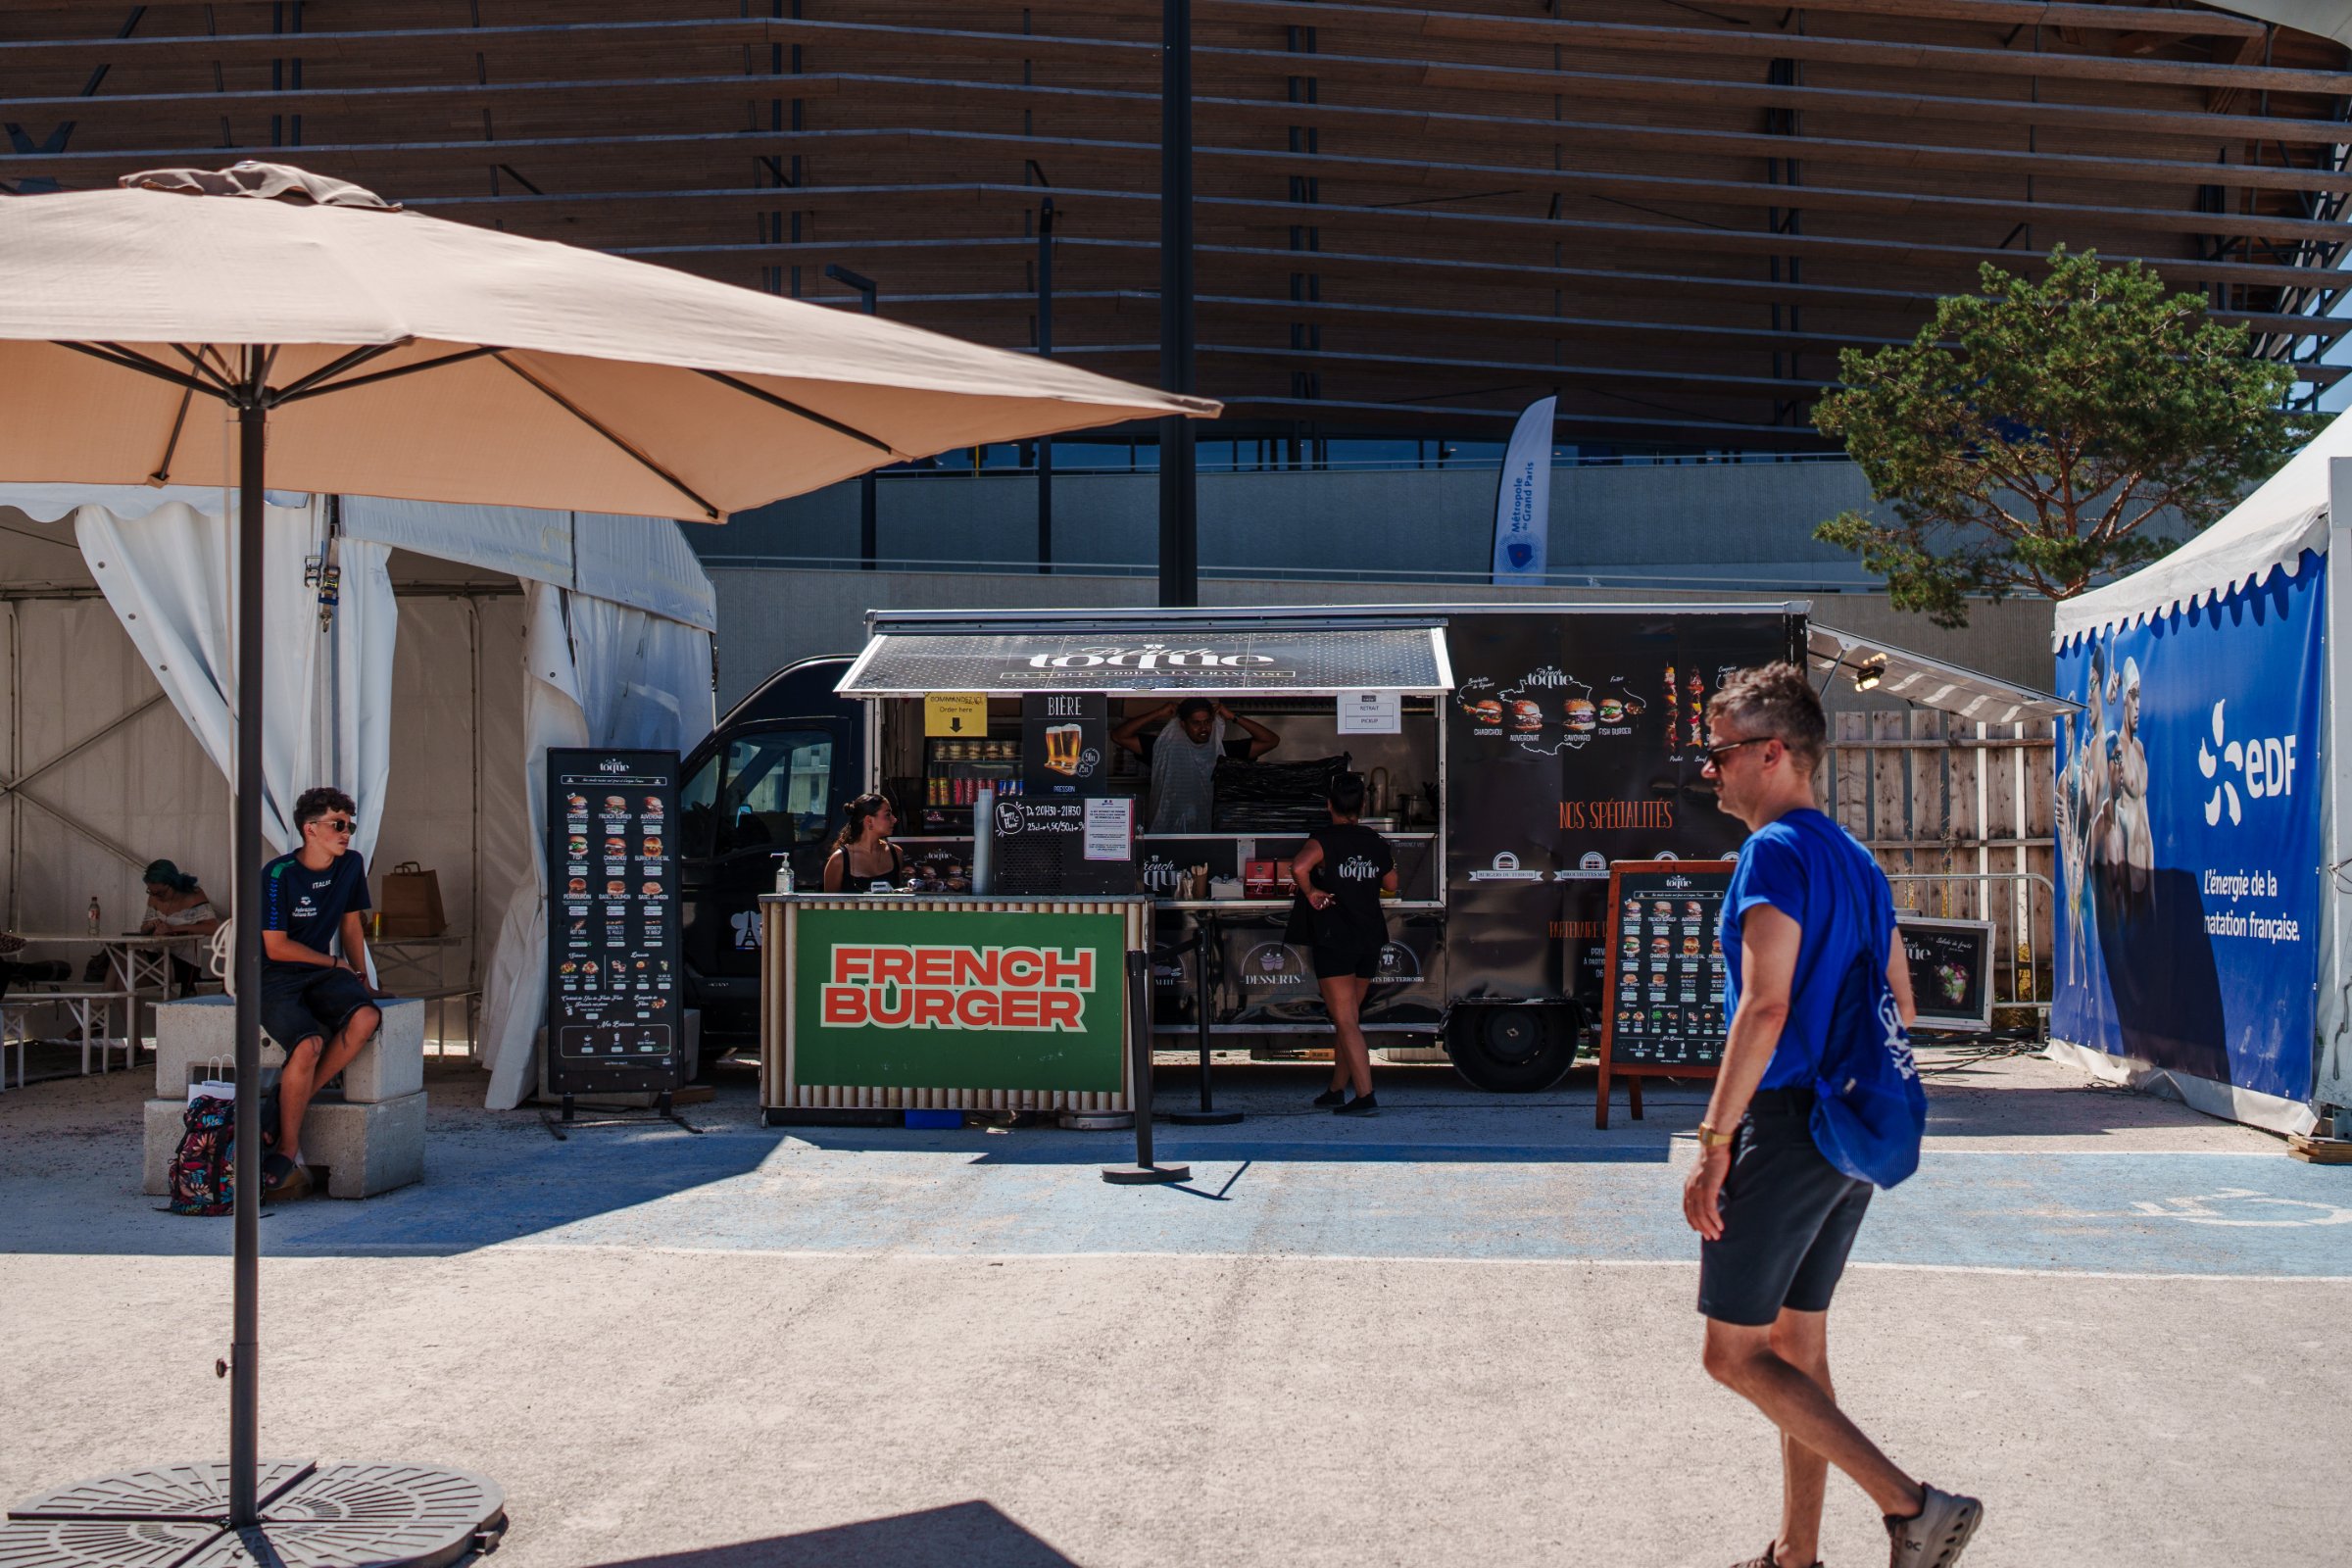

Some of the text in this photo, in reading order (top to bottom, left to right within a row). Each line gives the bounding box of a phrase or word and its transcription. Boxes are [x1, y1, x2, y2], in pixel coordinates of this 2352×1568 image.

[1512, 477, 1523, 532] Métropole
[1522, 462, 1534, 531] du Grand Paris
[1029, 654, 1274, 669] toque
[1527, 672, 1573, 689] toque
[1537, 667, 1562, 676] French
[1047, 694, 1082, 716] BIÈRE
[600, 762, 629, 773] toque
[999, 806, 1015, 820] Happy
[1559, 798, 1673, 829] NOS SPÉCIALITÉS
[1004, 817, 1018, 829] Hour
[1144, 860, 1175, 871] rench
[1339, 862, 1380, 882] toque
[1666, 878, 1692, 889] toque
[2204, 868, 2278, 903] L'énergie de la
[2204, 909, 2300, 945] natation française.
[832, 945, 1095, 991] FRENCH
[1245, 974, 1302, 985] DESSERTS
[821, 984, 1086, 1032] BURGER
